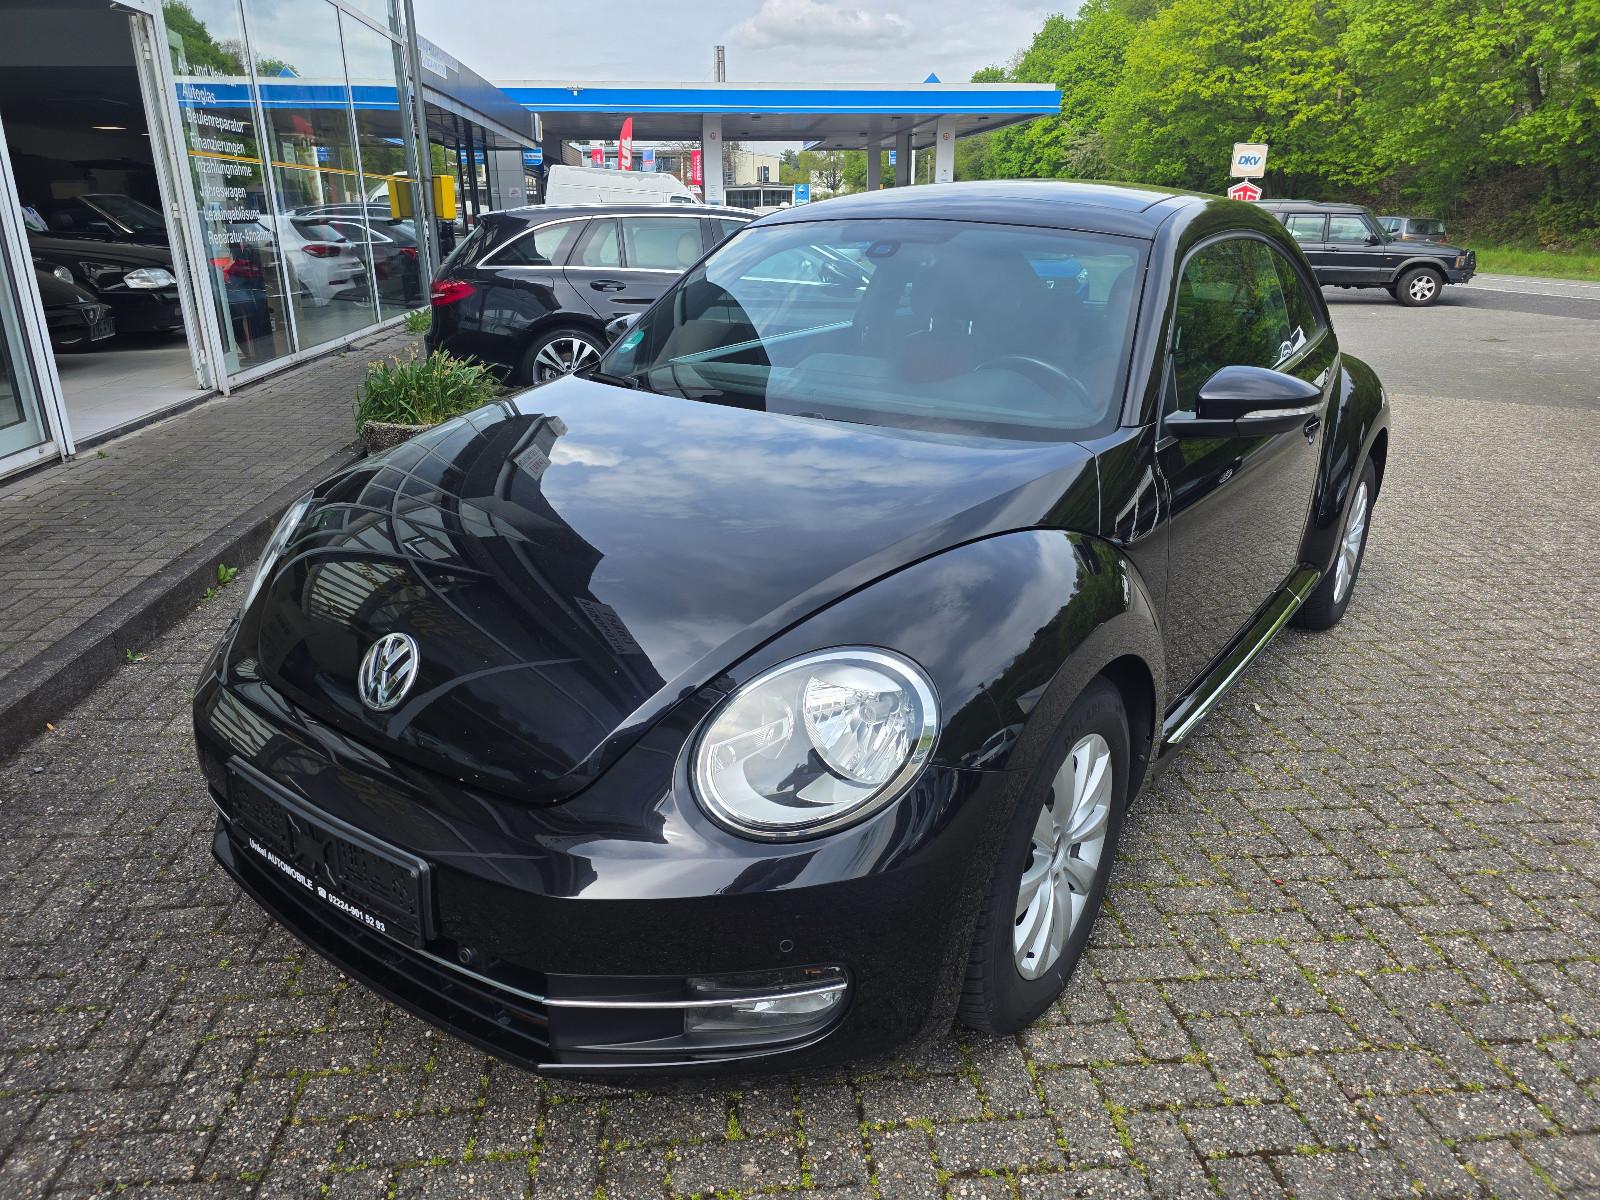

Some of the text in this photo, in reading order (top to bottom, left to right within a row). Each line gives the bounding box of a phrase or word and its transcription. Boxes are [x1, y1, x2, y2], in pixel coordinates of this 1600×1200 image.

[193, 63, 208, 77] und
[182, 84, 217, 105] Autoglas
[186, 108, 244, 133] Beulenreparatur
[190, 132, 245, 156] Finanzierungen
[1238, 156, 1261, 165] DKV
[199, 183, 247, 201] Jahreswagen
[249, 837, 386, 932] Unkel AUTOMOBILE 02224-901 52 93
